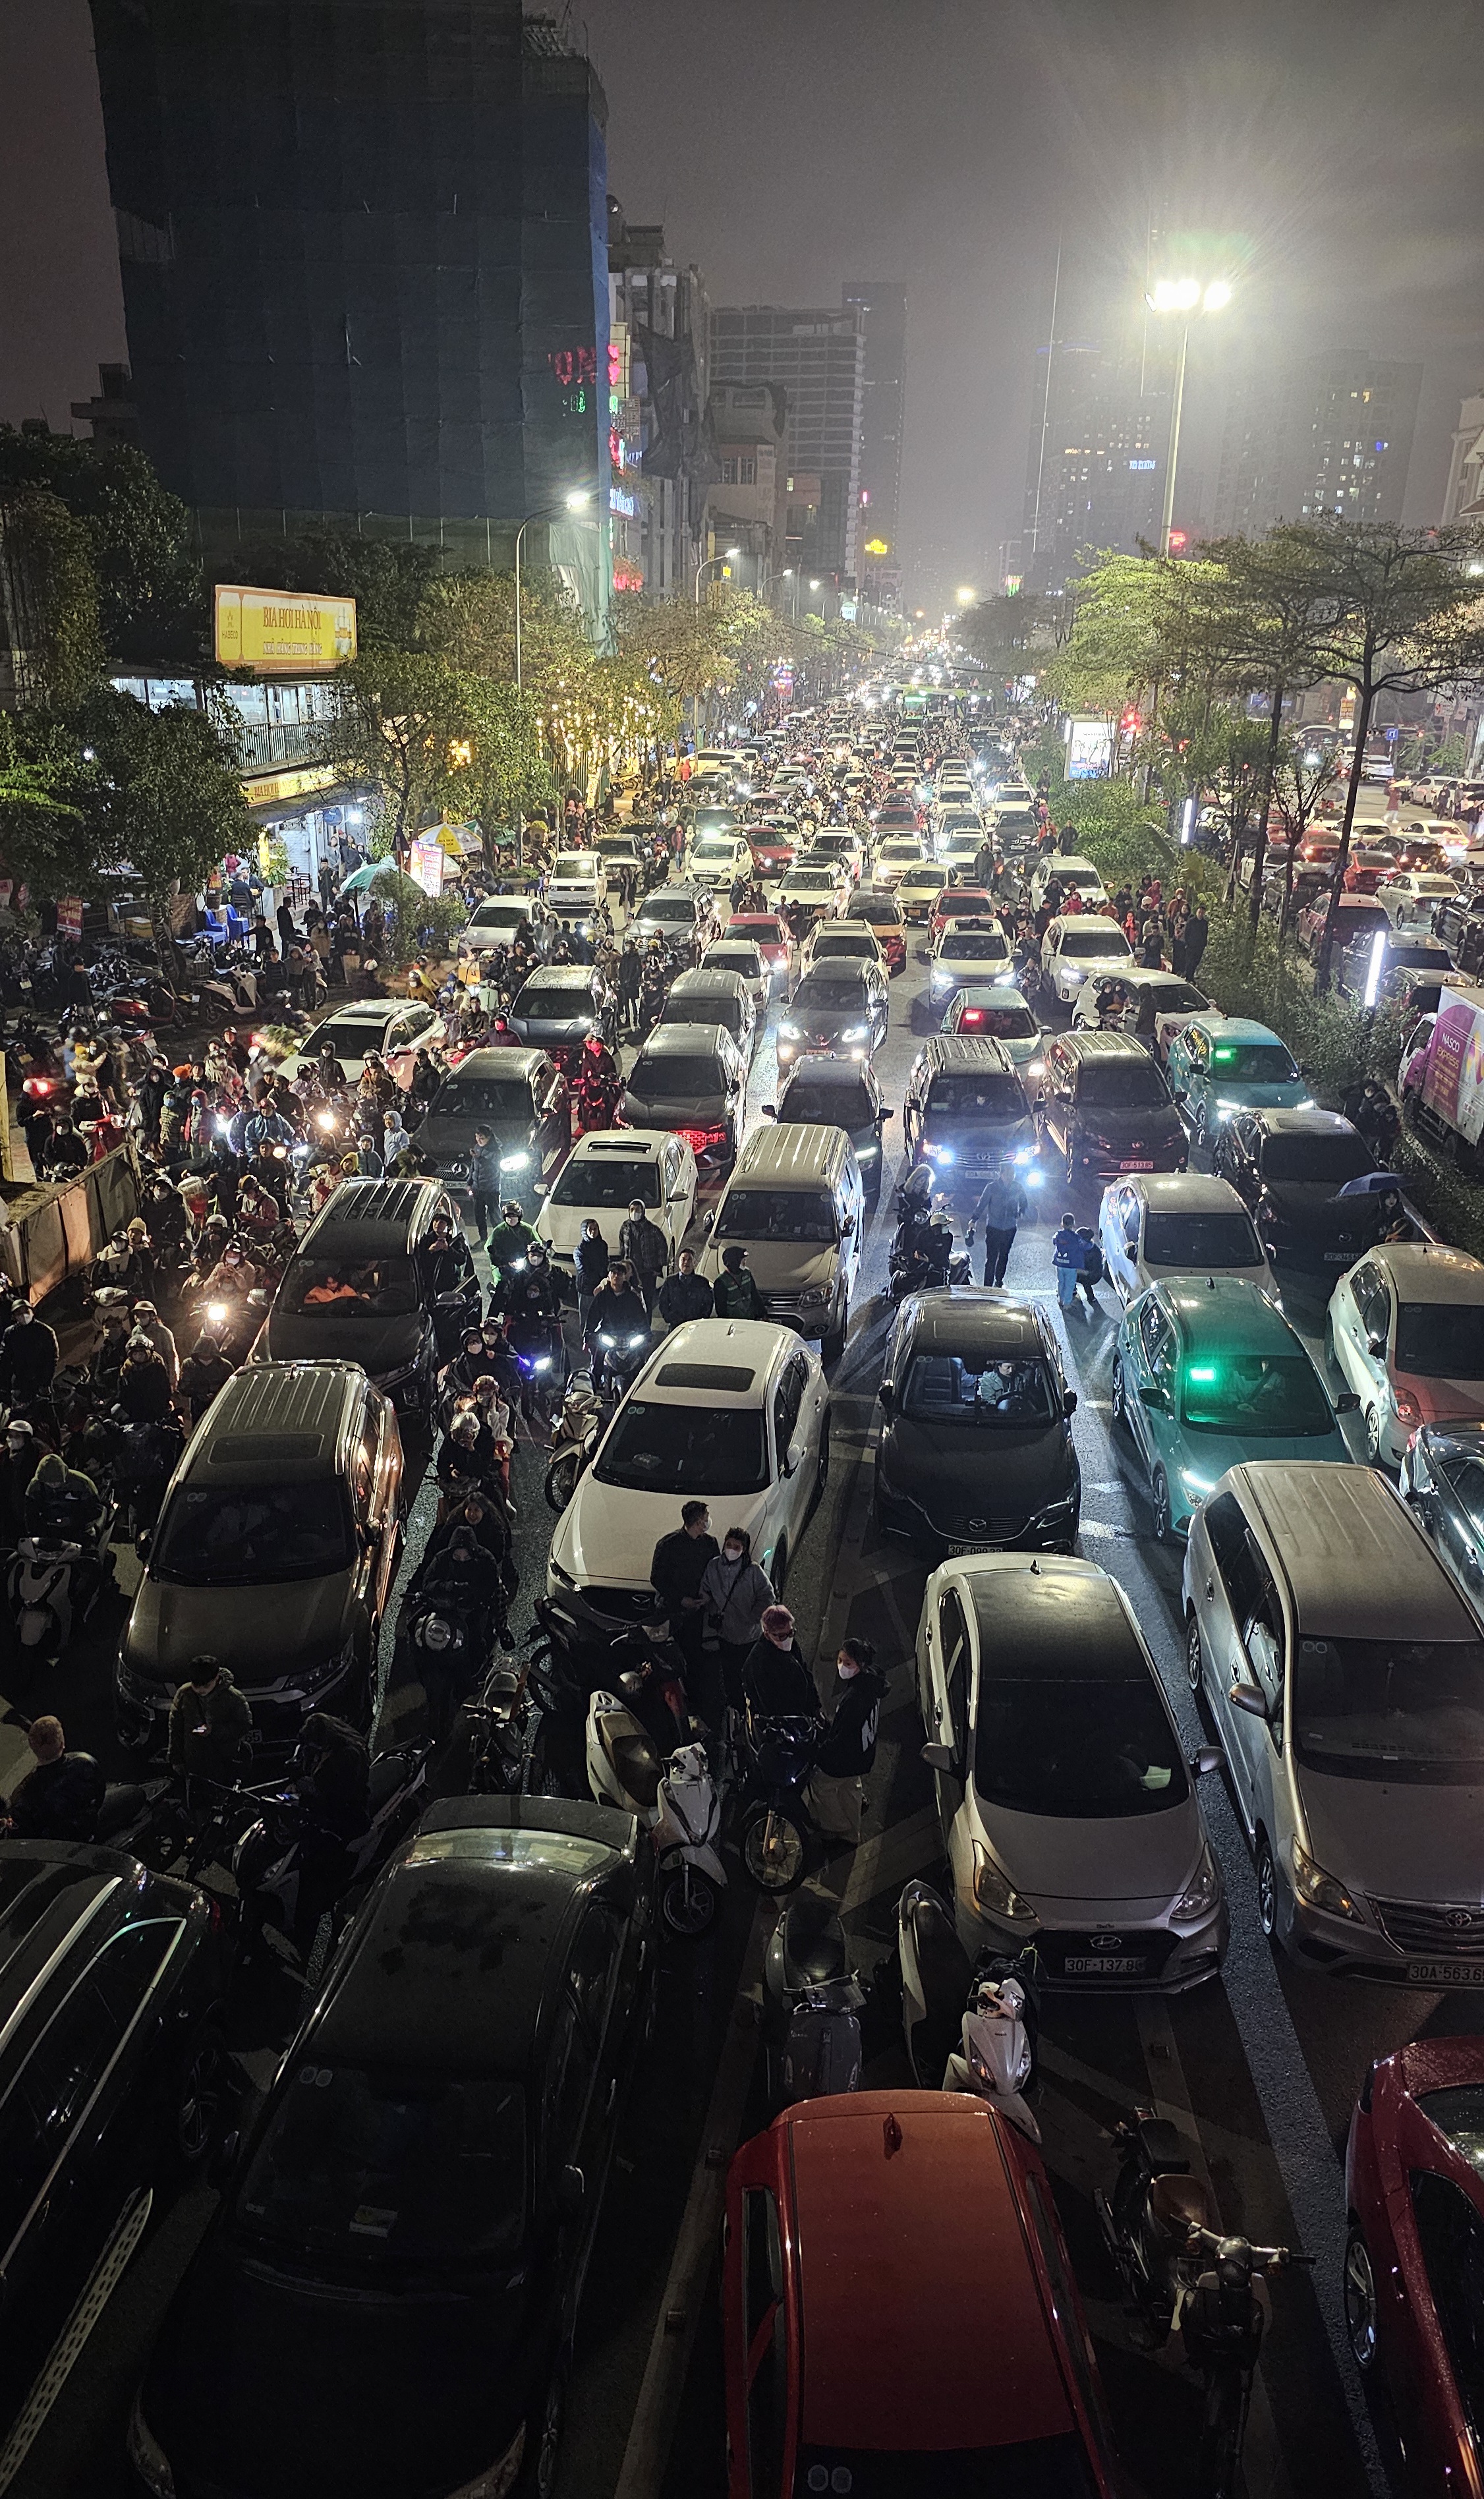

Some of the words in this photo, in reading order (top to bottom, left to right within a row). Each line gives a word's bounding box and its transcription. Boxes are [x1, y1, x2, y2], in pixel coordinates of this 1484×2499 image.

[263, 606, 277, 627] BIA
[295, 604, 307, 629] HÀ
[307, 607, 322, 635] NỘI
[221, 630, 238, 639] HABECO
[1442, 1032, 1460, 1052] NASCO
[1437, 1045, 1460, 1070] EXPRESS
[1410, 1965, 1484, 1981] 30A-563.6
